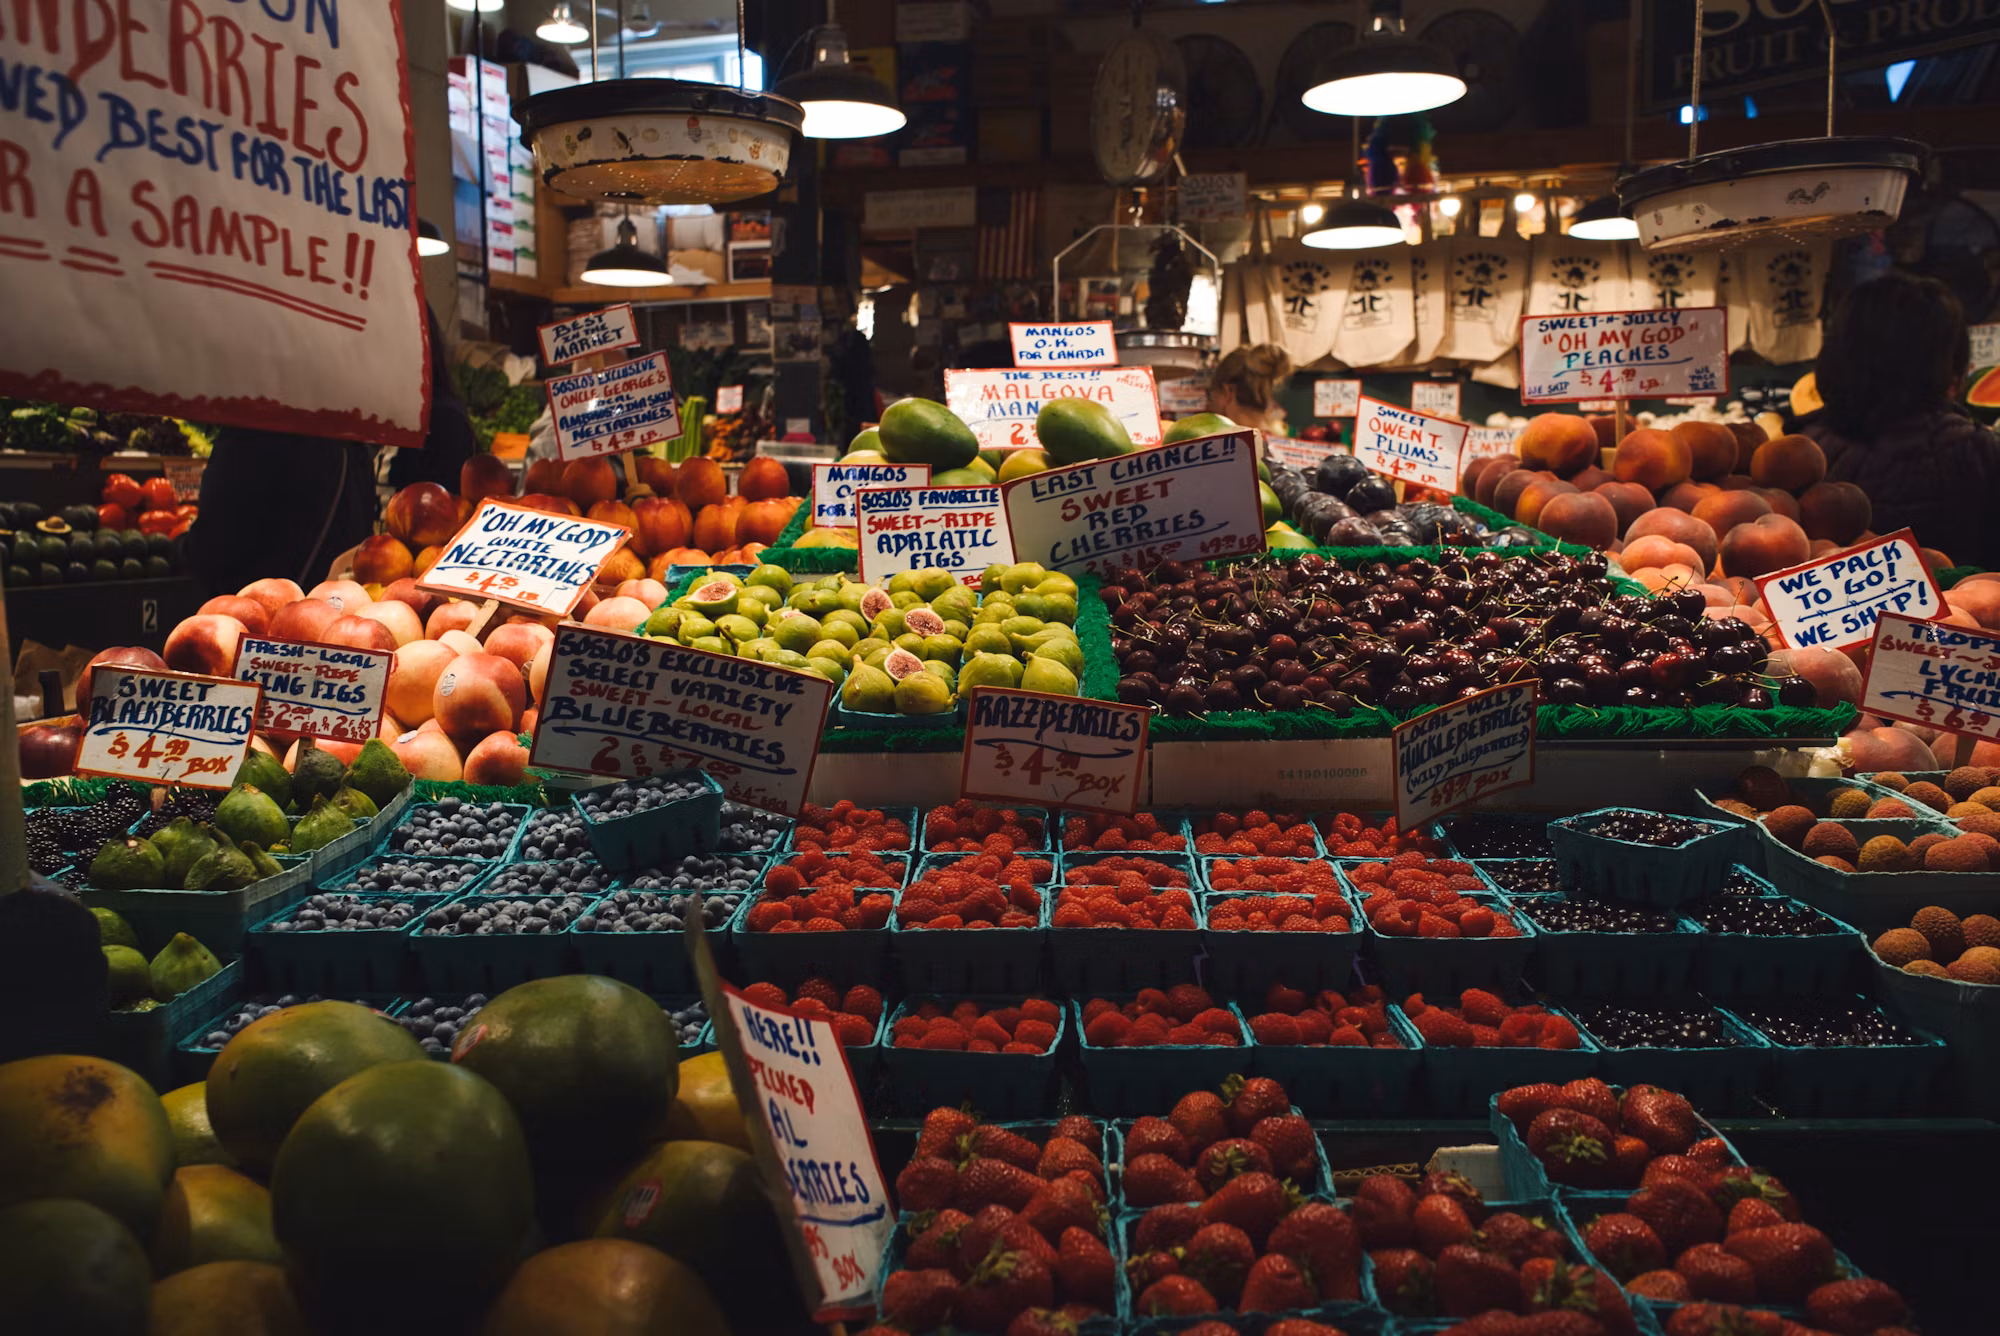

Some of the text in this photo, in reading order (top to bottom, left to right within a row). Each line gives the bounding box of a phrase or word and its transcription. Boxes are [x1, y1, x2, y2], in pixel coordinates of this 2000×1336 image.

[1672, 26, 1808, 91] FRUIT
[97, 92, 224, 172] BEST
[231, 132, 291, 195] FOR
[291, 156, 353, 217] THE
[356, 174, 413, 231] LAST
[66, 168, 109, 238] A
[131, 180, 376, 301] SAMPLE!!
[552, 312, 607, 343] BEST
[584, 323, 609, 336] THE
[1025, 326, 1096, 337] MANGOS
[1598, 328, 1633, 349] MY
[554, 325, 626, 362] MARKET
[1019, 348, 1105, 361] FOR CANADA
[1563, 344, 1670, 369] PEACHES
[597, 358, 657, 386] EXCLUSIVE
[603, 370, 667, 399] GEORGE'S
[1000, 371, 1034, 381] THE
[980, 383, 1114, 402] MALGOVA
[572, 406, 672, 441] NECTARINES
[987, 400, 1039, 419] MAN
[1377, 405, 1428, 427] SWEET
[1368, 416, 1423, 444] OWEN
[1374, 433, 1439, 463] PLUMS
[827, 466, 907, 482] MANGOS
[1030, 464, 1098, 499] LAST
[1110, 435, 1237, 481] CHANCE!!
[817, 504, 847, 517] FOR
[861, 490, 913, 511] SOSIO'S
[918, 487, 1000, 506] FAVORITE
[1061, 477, 1176, 523] SWEET
[519, 516, 565, 540] MY
[1083, 502, 1149, 532] RED
[487, 536, 556, 555] WHITE
[876, 528, 998, 558] ADRIATIC
[1049, 509, 1206, 563] CHERRIES
[443, 541, 599, 586] NECTARINES
[910, 551, 965, 570] FIGS
[1778, 540, 1903, 595] WE PACK
[1794, 561, 1898, 611] TO GO!
[144, 601, 156, 630] 2
[1794, 622, 1837, 648] WE
[557, 632, 806, 696] SOSIO'S EXCLUSIVE
[1918, 659, 2000, 690] LYCH
[117, 673, 217, 702] SWEET
[240, 669, 366, 704] KING FIGS
[567, 658, 793, 727] SELECT VARIETY
[88, 696, 254, 736] BLACKBERRIES
[542, 695, 786, 766] BLUEBERRIES
[973, 695, 1141, 742] RAZZBERRIES
[590, 735, 621, 773] 2
[1399, 700, 1534, 778] HUCKLEBERRIES
[179, 755, 233, 778] BOX
[1473, 766, 1513, 796] BOX
[1063, 772, 1127, 804] BOX
[832, 1249, 866, 1292] BOX
